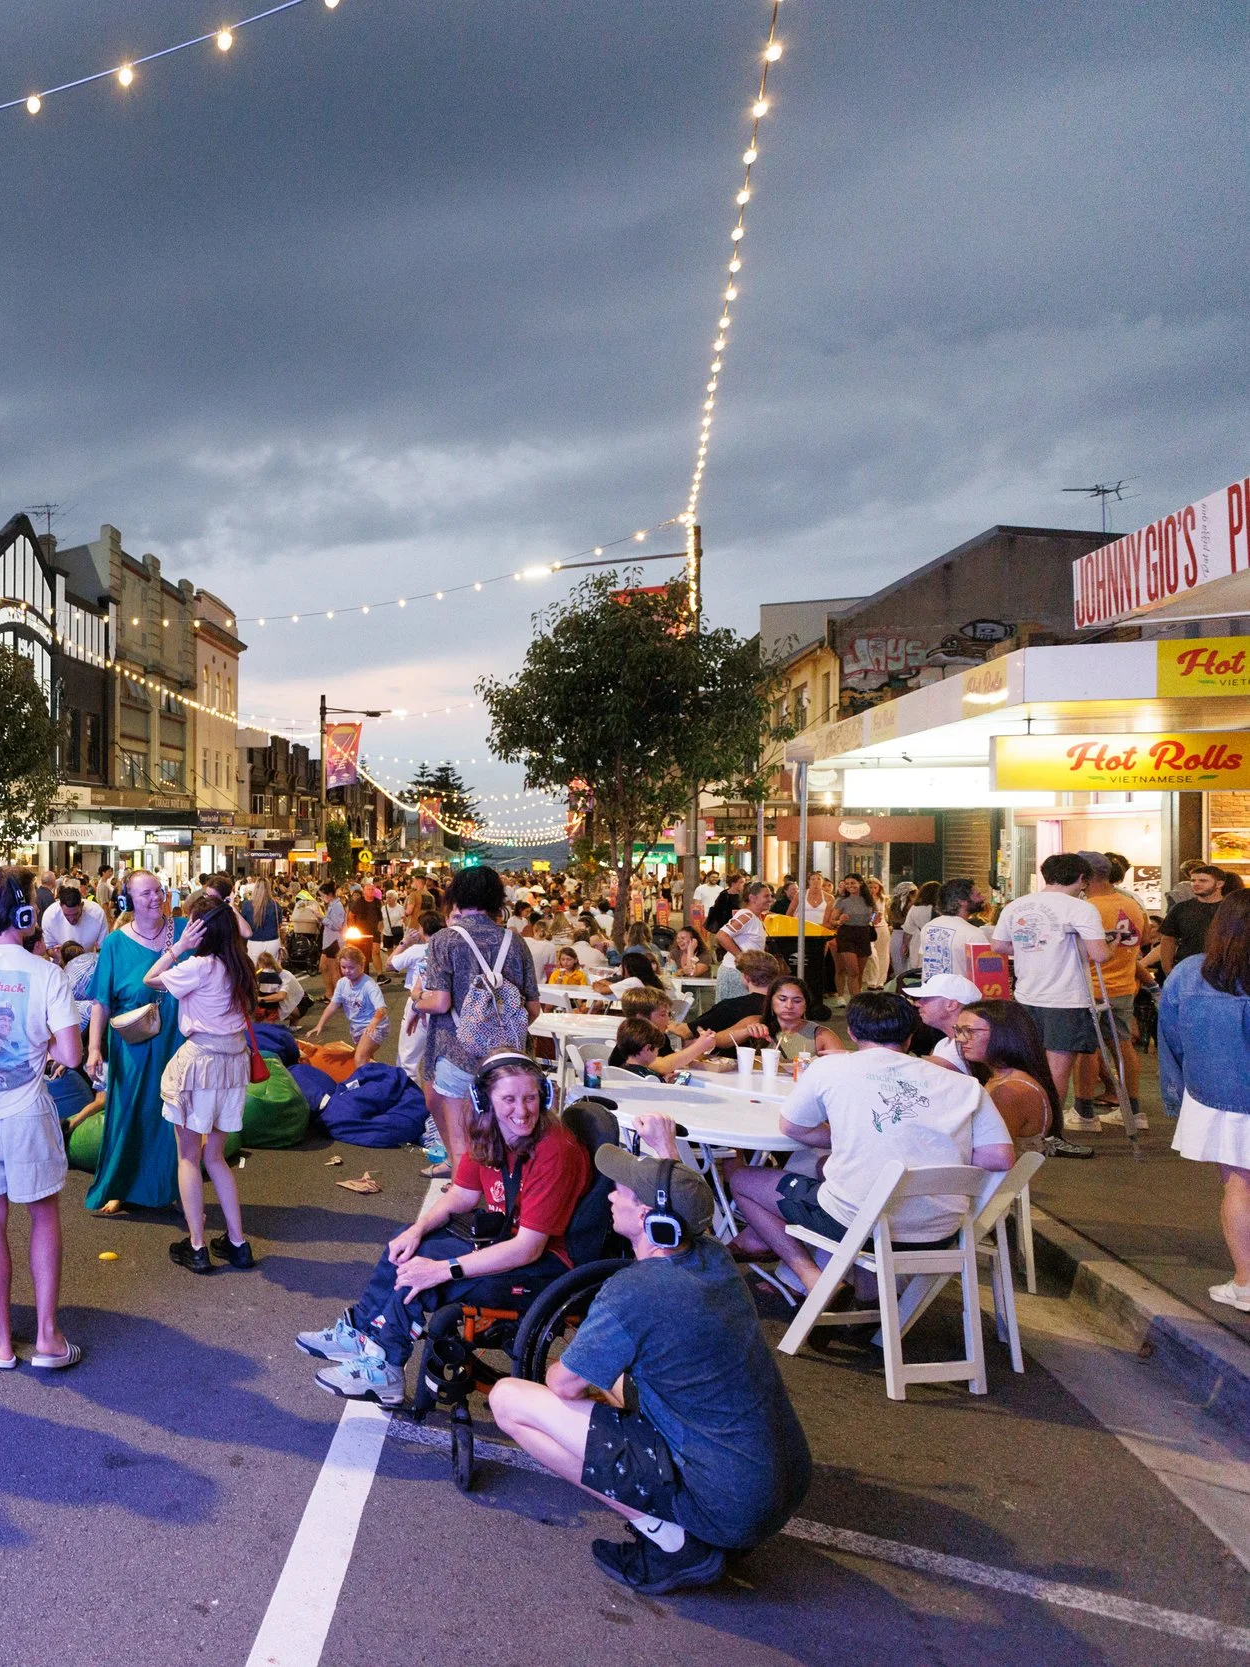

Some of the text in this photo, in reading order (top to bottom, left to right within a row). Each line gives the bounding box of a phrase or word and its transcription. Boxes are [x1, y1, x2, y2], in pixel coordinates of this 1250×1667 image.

[1201, 525, 1211, 552] pizza
[1076, 505, 1198, 628] JOHNNY GIO'S
[1177, 647, 1246, 676] Hot
[1066, 740, 1243, 771] Hot Rolls
